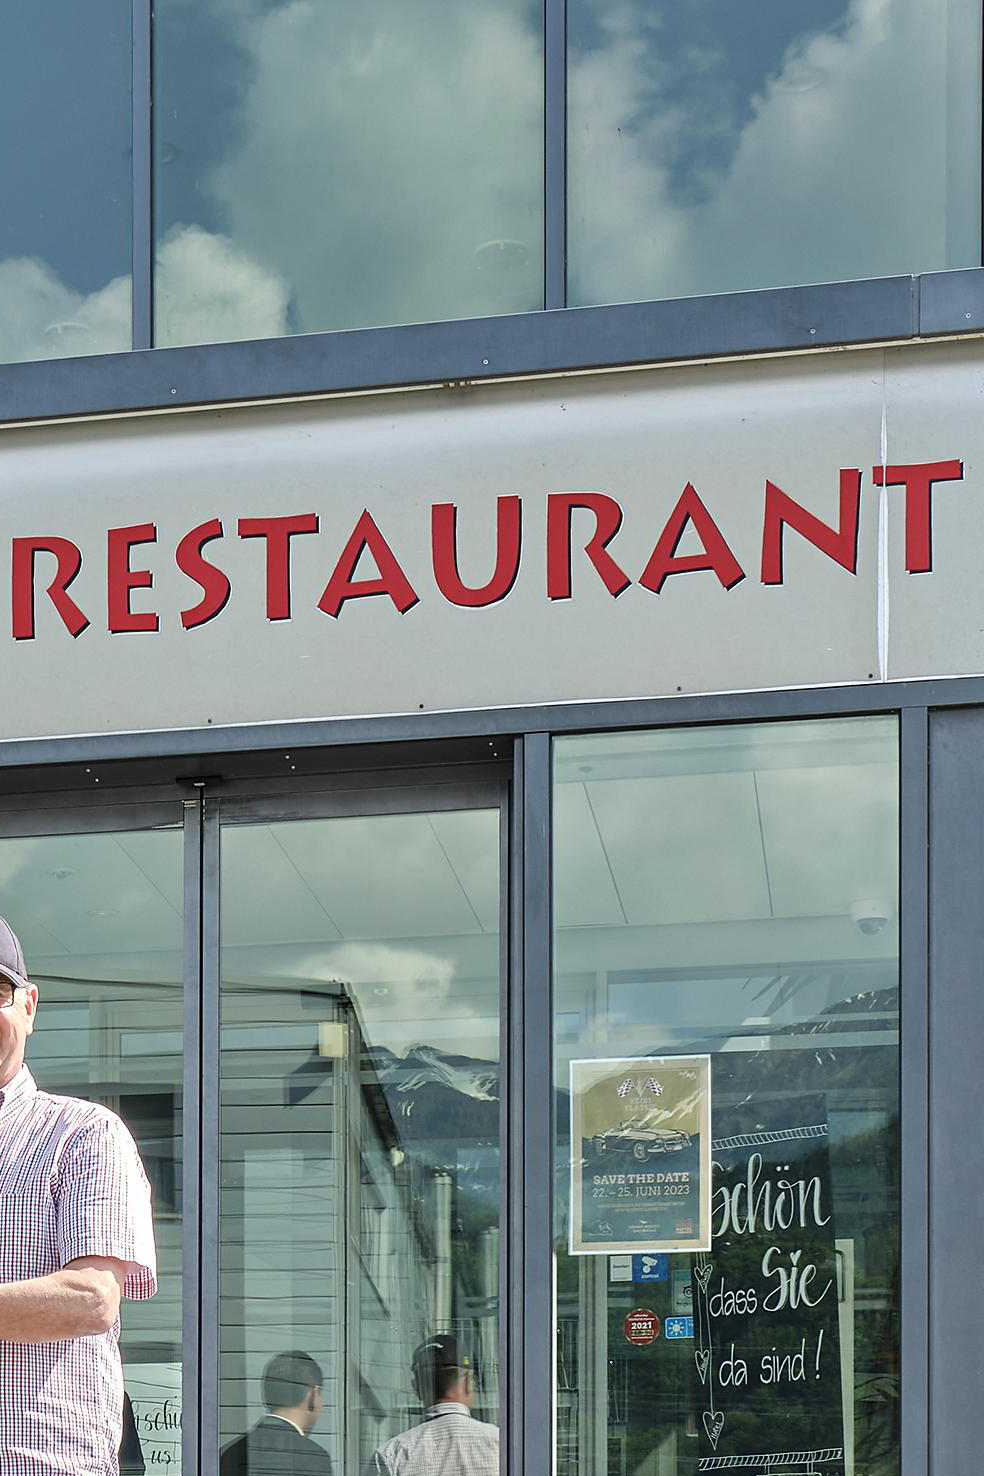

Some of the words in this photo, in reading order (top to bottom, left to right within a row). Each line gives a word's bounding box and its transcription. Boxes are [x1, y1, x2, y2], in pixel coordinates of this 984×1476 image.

[12, 459, 964, 640] RESTAURANT
[593, 1174, 625, 1185] SAVE
[627, 1173, 654, 1184] THE
[656, 1172, 690, 1183] DATE
[636, 1186, 661, 1197] JUNI
[663, 1185, 690, 1195] 2023
[709, 1277, 758, 1317] dass
[762, 1247, 833, 1312] Sie
[631, 1321, 652, 1329] 2021
[719, 1343, 748, 1386] da
[759, 1338, 806, 1384] sind
